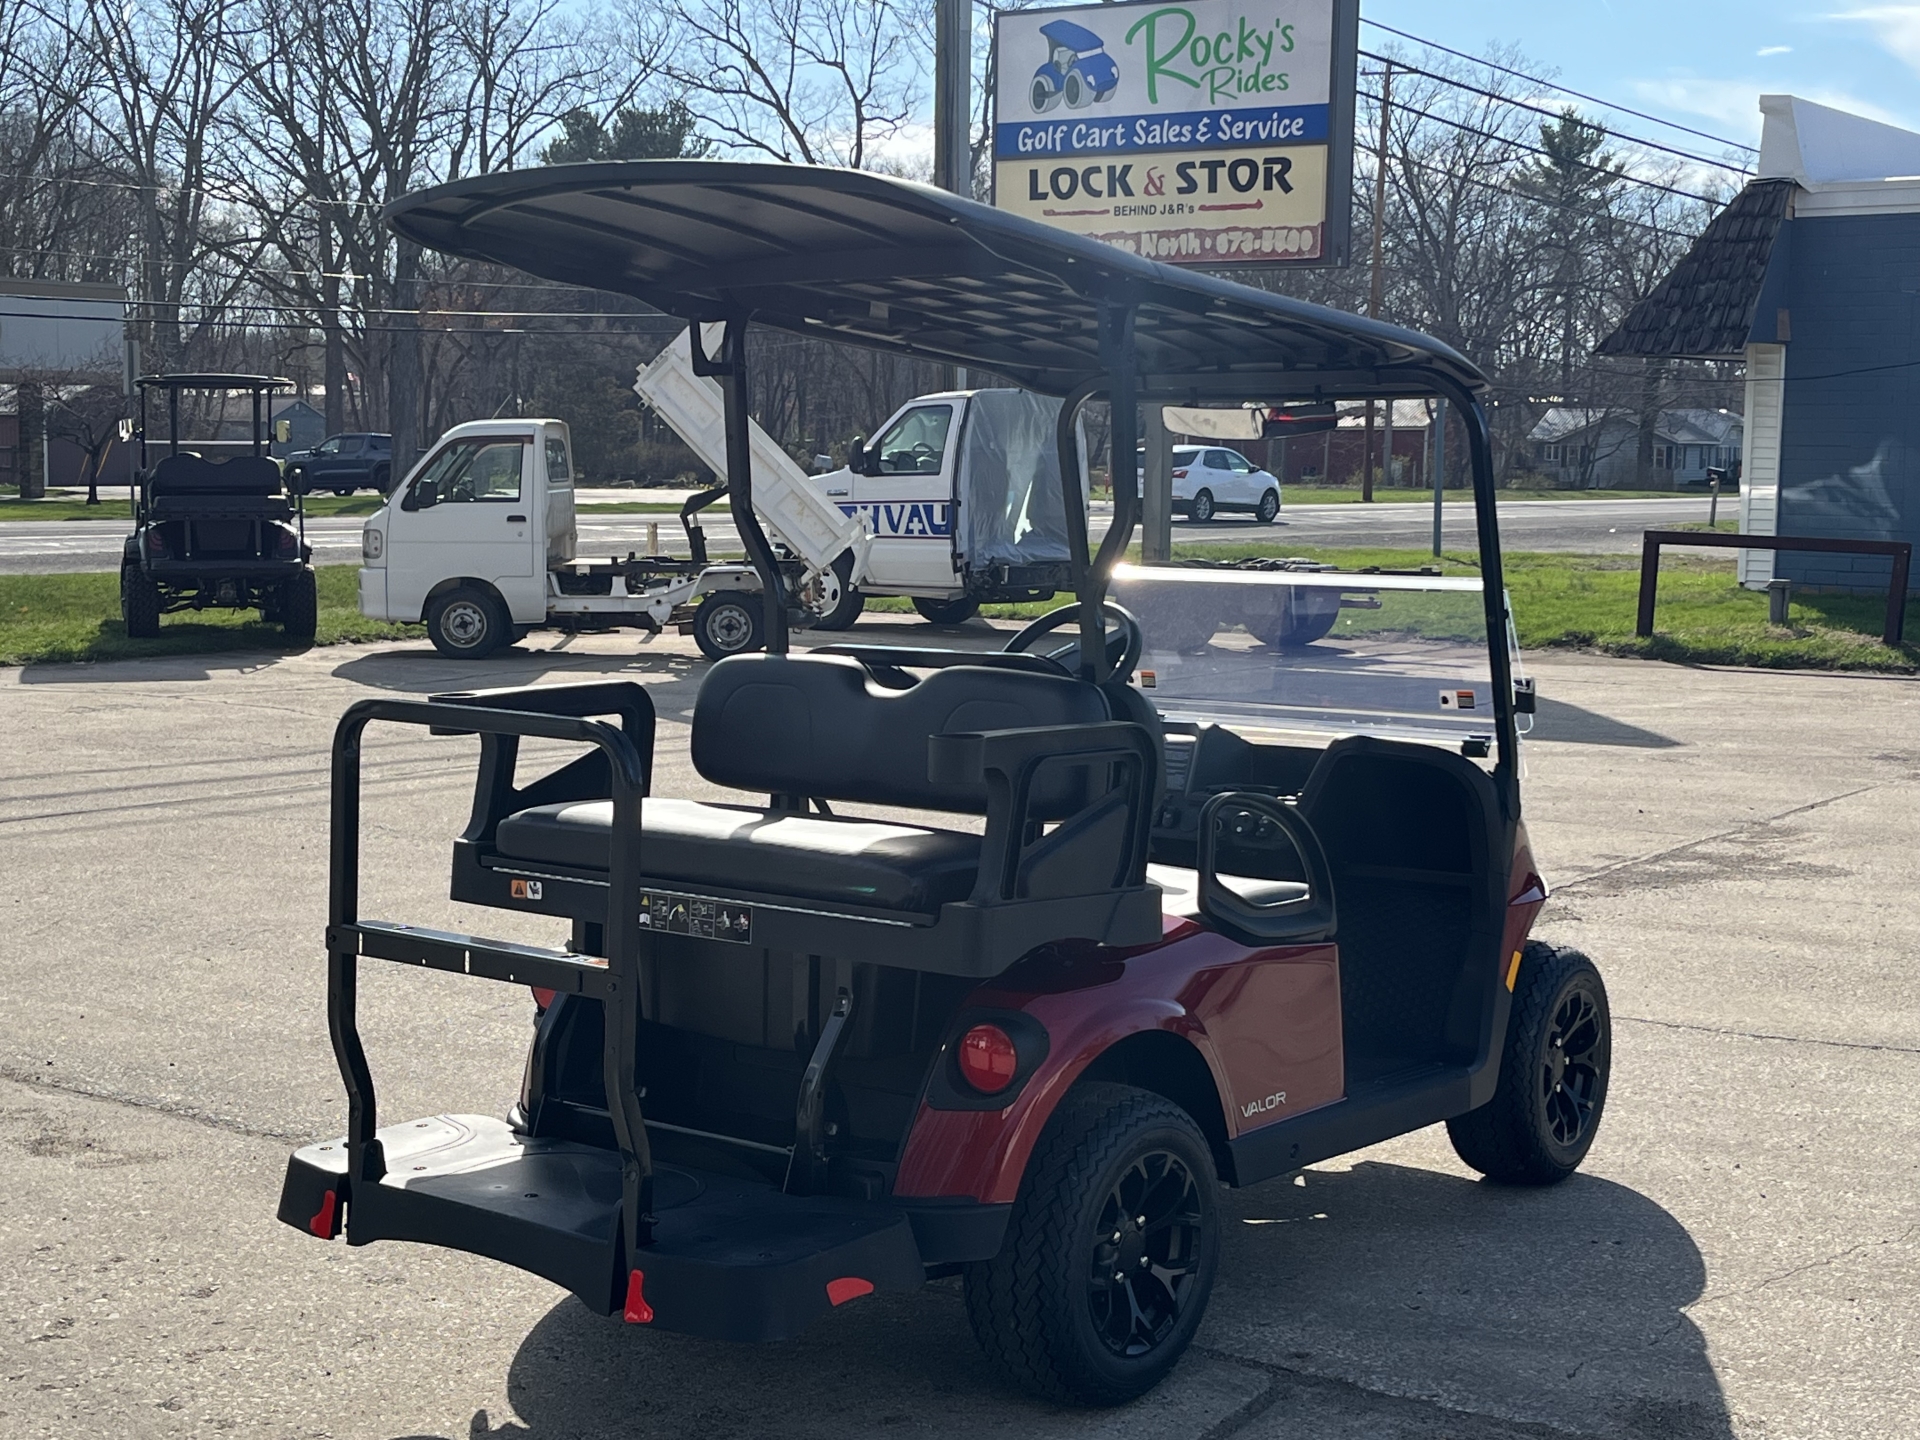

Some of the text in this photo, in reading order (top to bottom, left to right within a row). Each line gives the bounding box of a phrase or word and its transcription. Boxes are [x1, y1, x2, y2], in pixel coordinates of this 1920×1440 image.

[1125, 7, 1295, 104] Rocky's
[1200, 61, 1290, 105] Rides
[1018, 112, 1304, 153] Golf Cart Sales & Service
[1028, 157, 1294, 201] LOCK & STOR
[1113, 202, 1195, 217] BEHIND J&R's
[1241, 1091, 1286, 1118] VALOR
